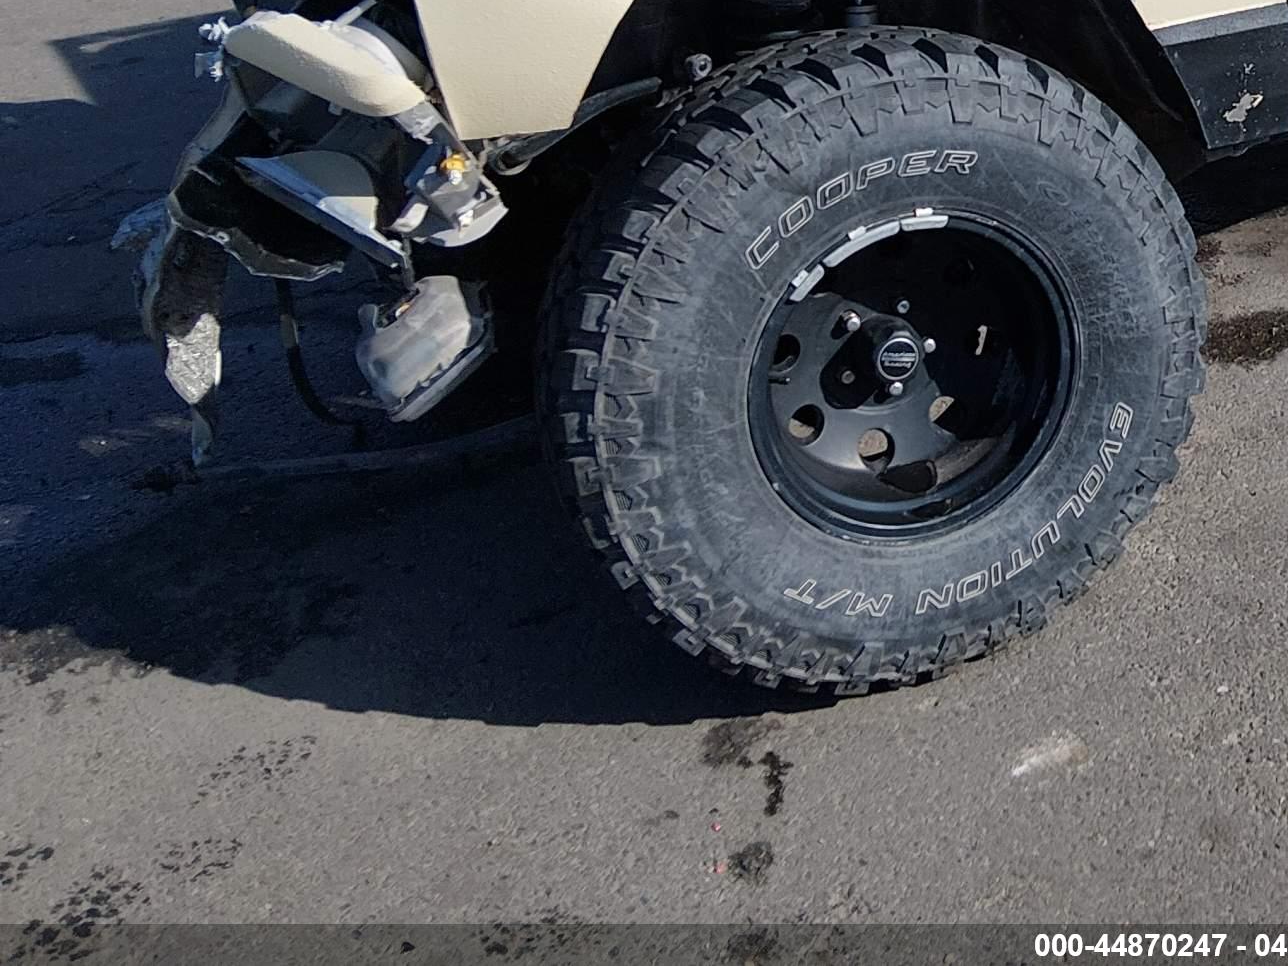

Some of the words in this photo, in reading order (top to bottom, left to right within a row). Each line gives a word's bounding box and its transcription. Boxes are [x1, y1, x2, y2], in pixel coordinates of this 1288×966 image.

[745, 149, 979, 270] COOPER
[914, 401, 1134, 615] EVOLUTION
[783, 578, 893, 618] M/T
